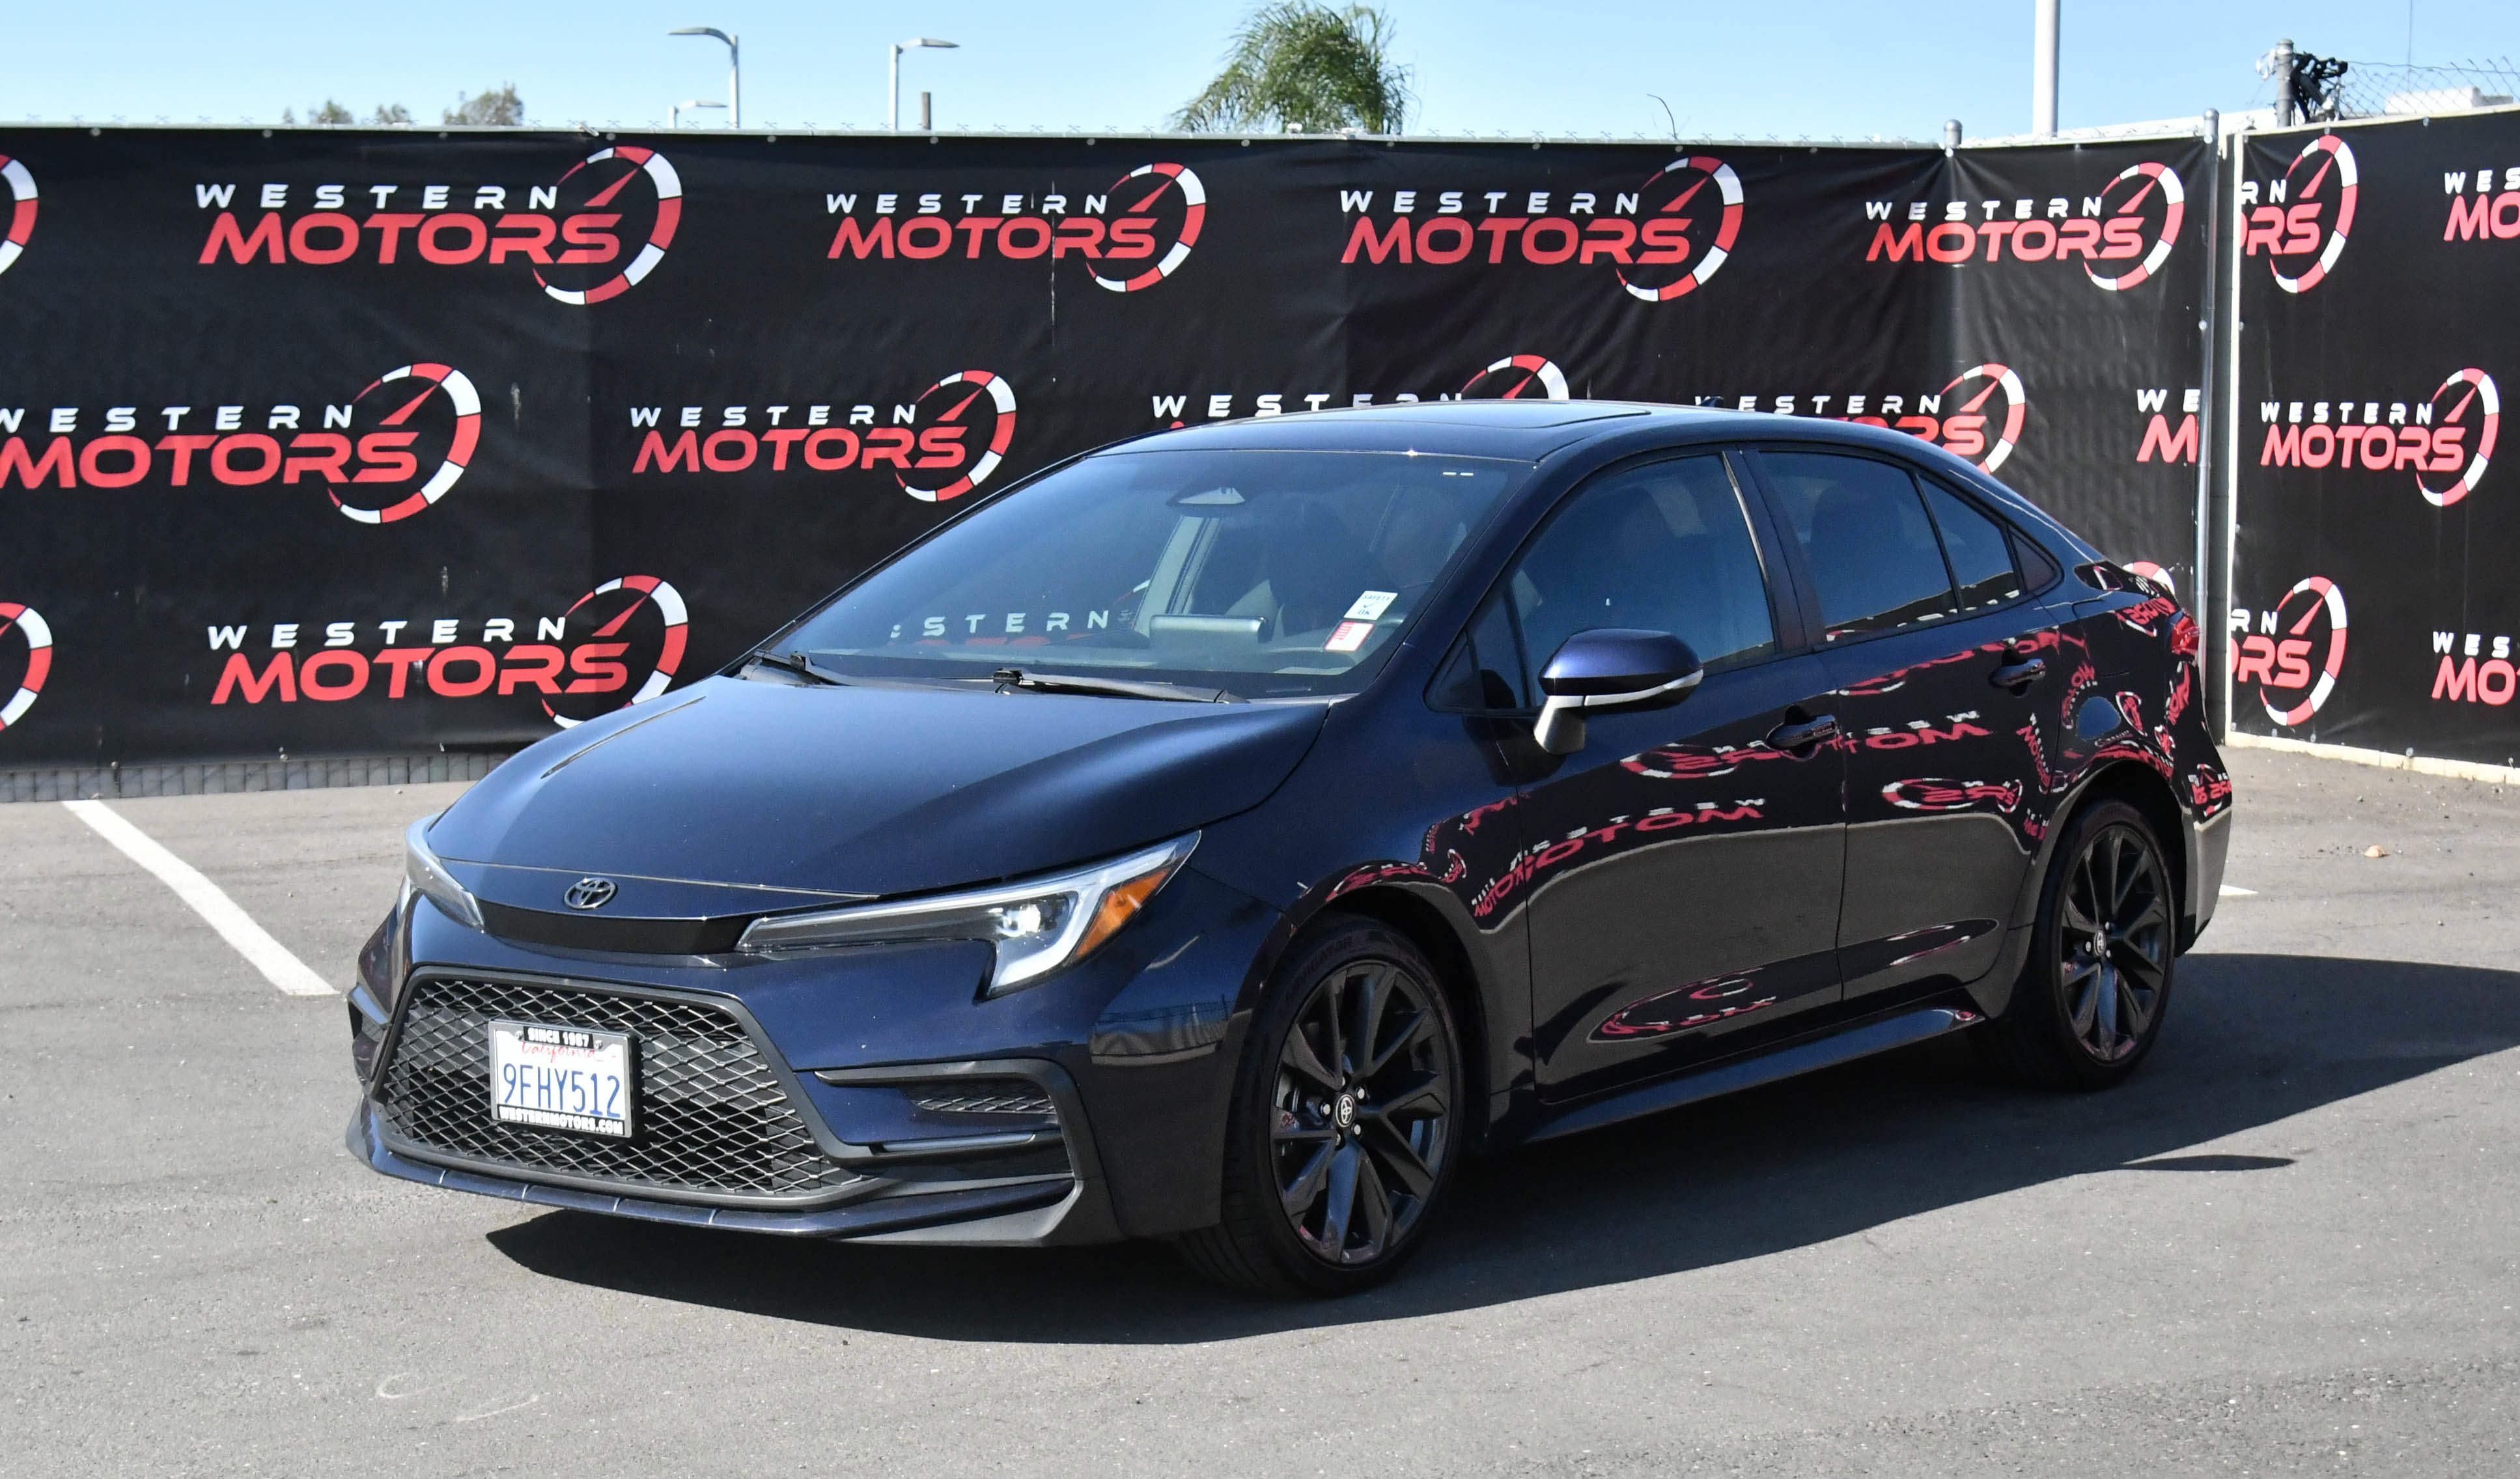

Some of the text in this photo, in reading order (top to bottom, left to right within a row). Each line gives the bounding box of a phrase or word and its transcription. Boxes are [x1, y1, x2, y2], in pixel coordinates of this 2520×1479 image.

[197, 184, 557, 209] WESTERN
[2444, 167, 2520, 194] WES
[827, 194, 1106, 214] WESTERN
[1341, 191, 1638, 214] WESTERN
[1866, 197, 2101, 221] WESTERN
[2443, 191, 2520, 242] MO
[199, 212, 621, 264] MOTORS
[828, 217, 1157, 259] MOTORS
[1341, 216, 1692, 264] MOTORS
[1866, 217, 2144, 263] MOTORS
[2241, 203, 2323, 257] RS
[631, 404, 916, 427] WESTERN
[2136, 389, 2201, 412] WE
[2261, 402, 2432, 425] WESTERN
[0, 405, 352, 432] WESTERN
[0, 432, 419, 488] MOTORS
[633, 427, 967, 473] MOTORS
[2260, 424, 2466, 472] MOTORS
[1362, 593, 1392, 602] SAFETY
[208, 617, 565, 650] WESTERN
[2433, 630, 2511, 658] WES
[211, 643, 629, 704] MOTORS
[2231, 635, 2312, 689] RS
[2431, 655, 2520, 705] MO
[527, 1027, 560, 1044] SINCE
[503, 1063, 621, 1118] 9FHY512
[499, 1105, 624, 1135] WESTERNMOTORS.COM
